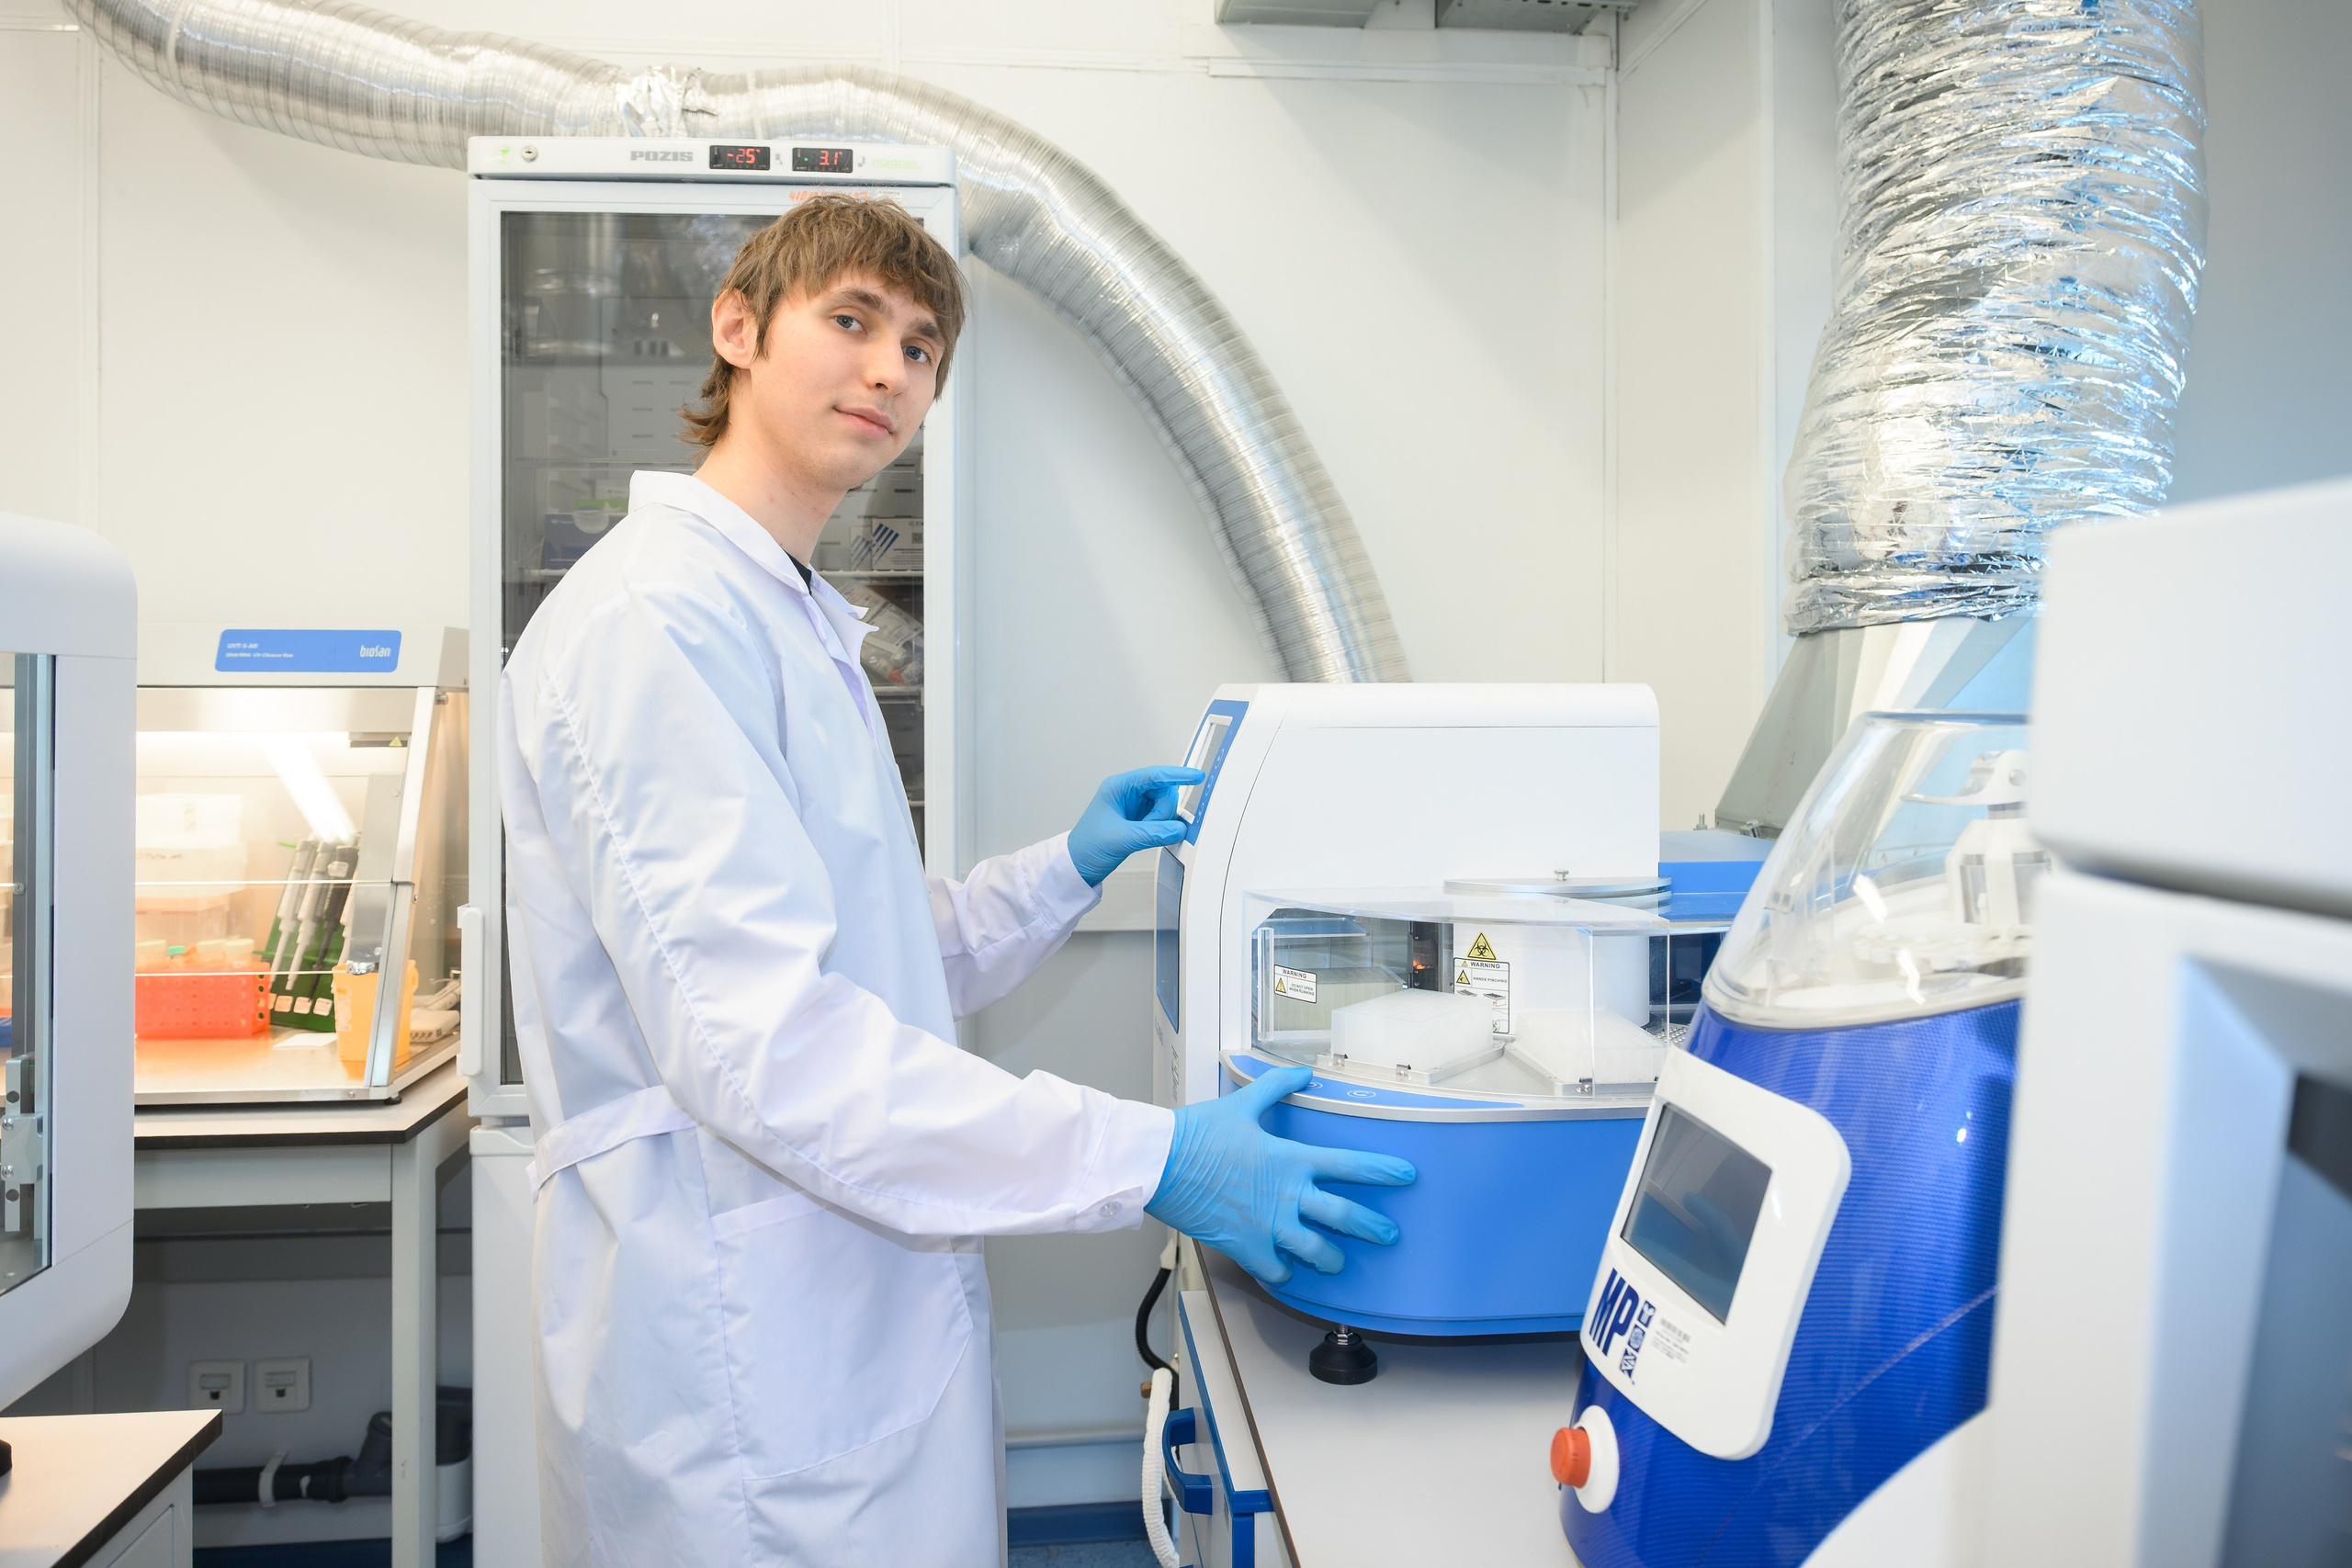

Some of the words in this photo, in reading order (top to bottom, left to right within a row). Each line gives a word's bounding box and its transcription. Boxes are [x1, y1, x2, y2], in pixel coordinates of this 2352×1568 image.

[630, 151, 694, 163] POZIS
[360, 644, 391, 658] biosan
[1470, 961, 1500, 969] WARNING
[1283, 968, 1307, 979] WARNING
[1589, 1268, 1639, 1357] MP
